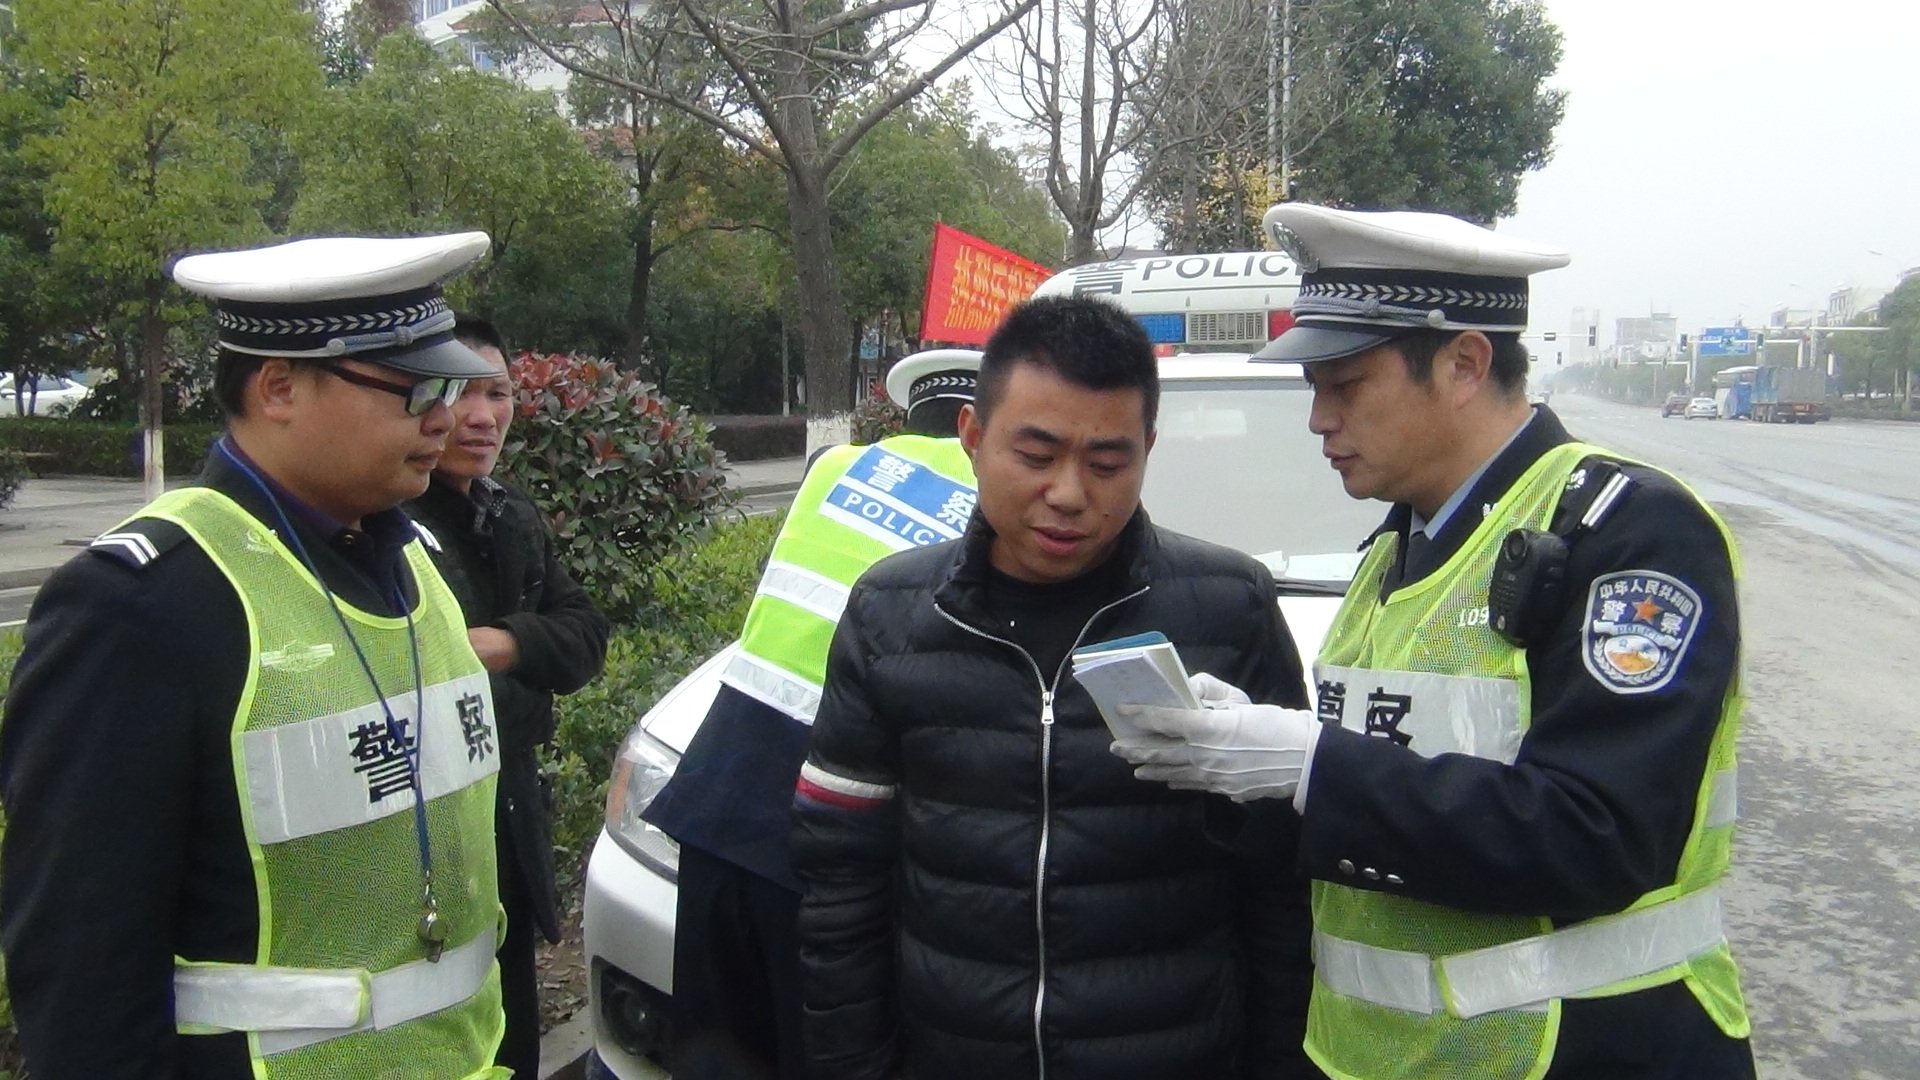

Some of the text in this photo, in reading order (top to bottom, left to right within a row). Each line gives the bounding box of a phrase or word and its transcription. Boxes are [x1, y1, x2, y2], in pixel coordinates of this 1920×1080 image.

[1142, 253, 1304, 281] POLIC
[842, 491, 947, 546] POLIC
[867, 454, 977, 533] 警察
[1599, 579, 1693, 617] 中华人民共和国
[348, 692, 494, 804] 警察
